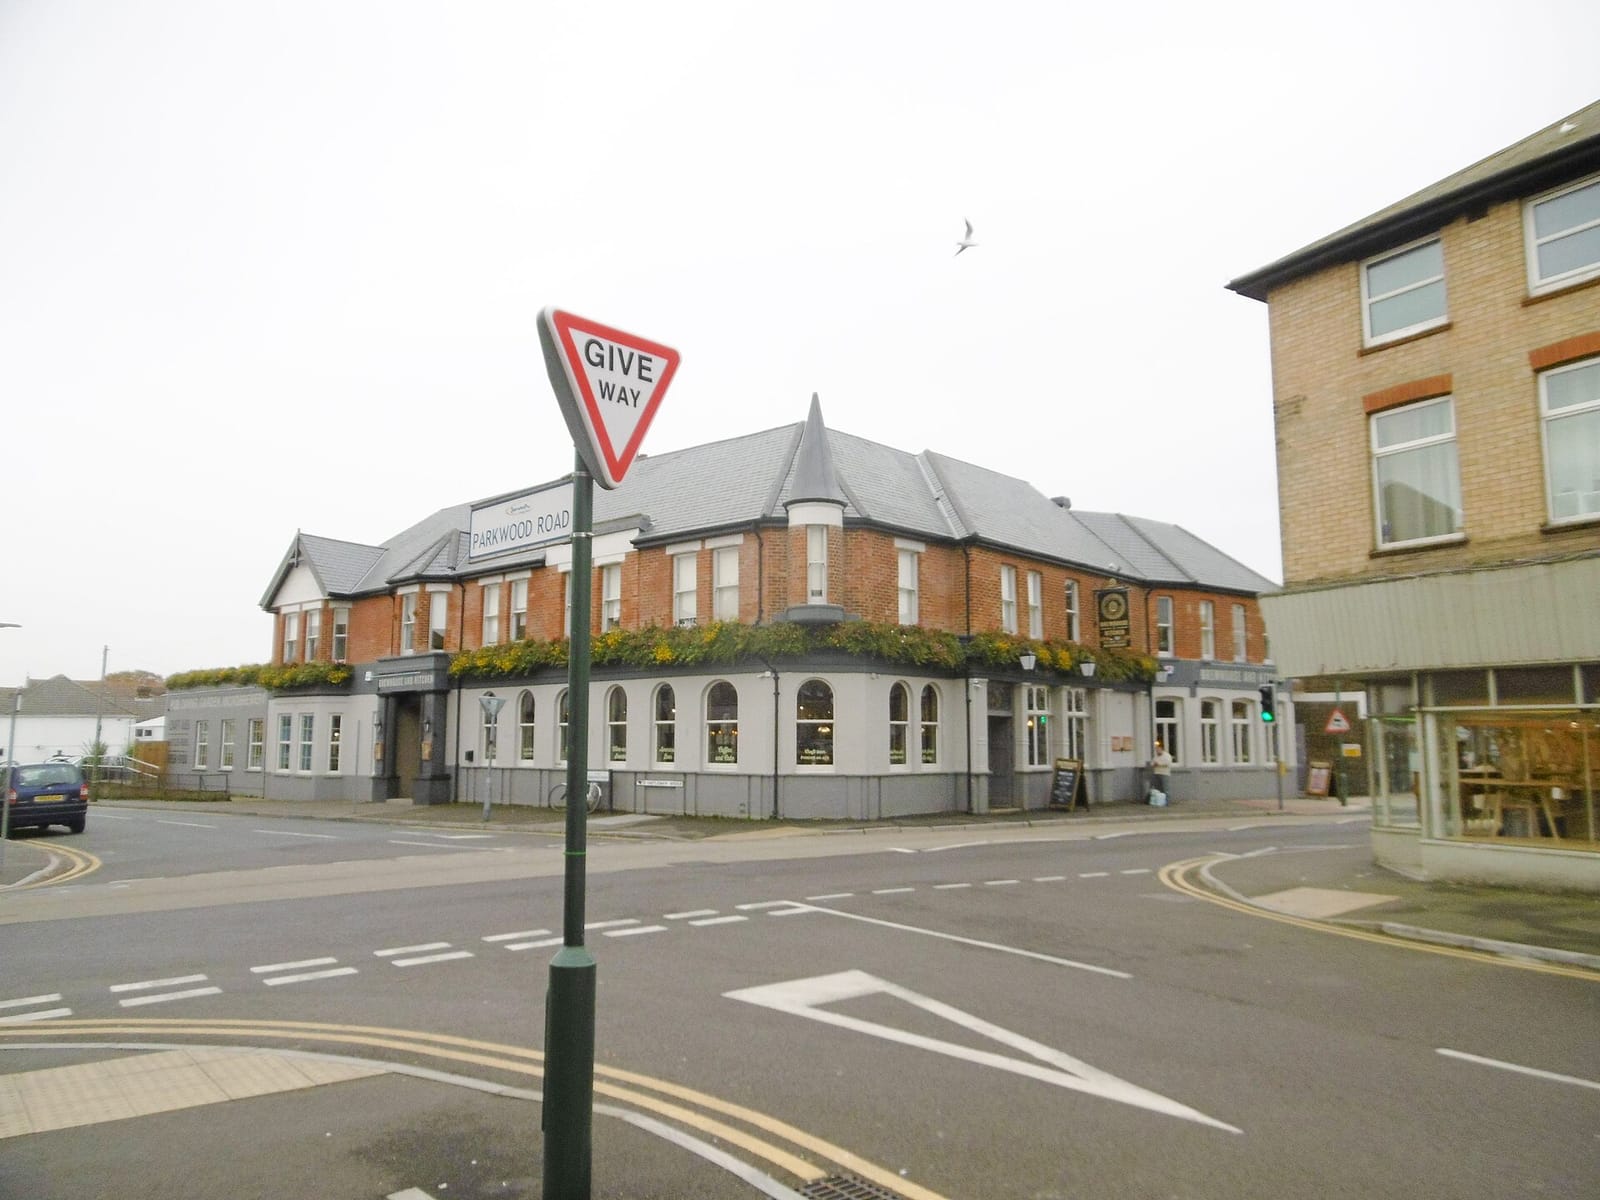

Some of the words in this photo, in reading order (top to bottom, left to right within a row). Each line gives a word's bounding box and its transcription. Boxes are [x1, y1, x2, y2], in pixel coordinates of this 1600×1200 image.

[584, 338, 653, 383] GIVE
[598, 378, 641, 408] WAY
[472, 519, 533, 550] PARKWOOD
[537, 510, 570, 535] ROAD
